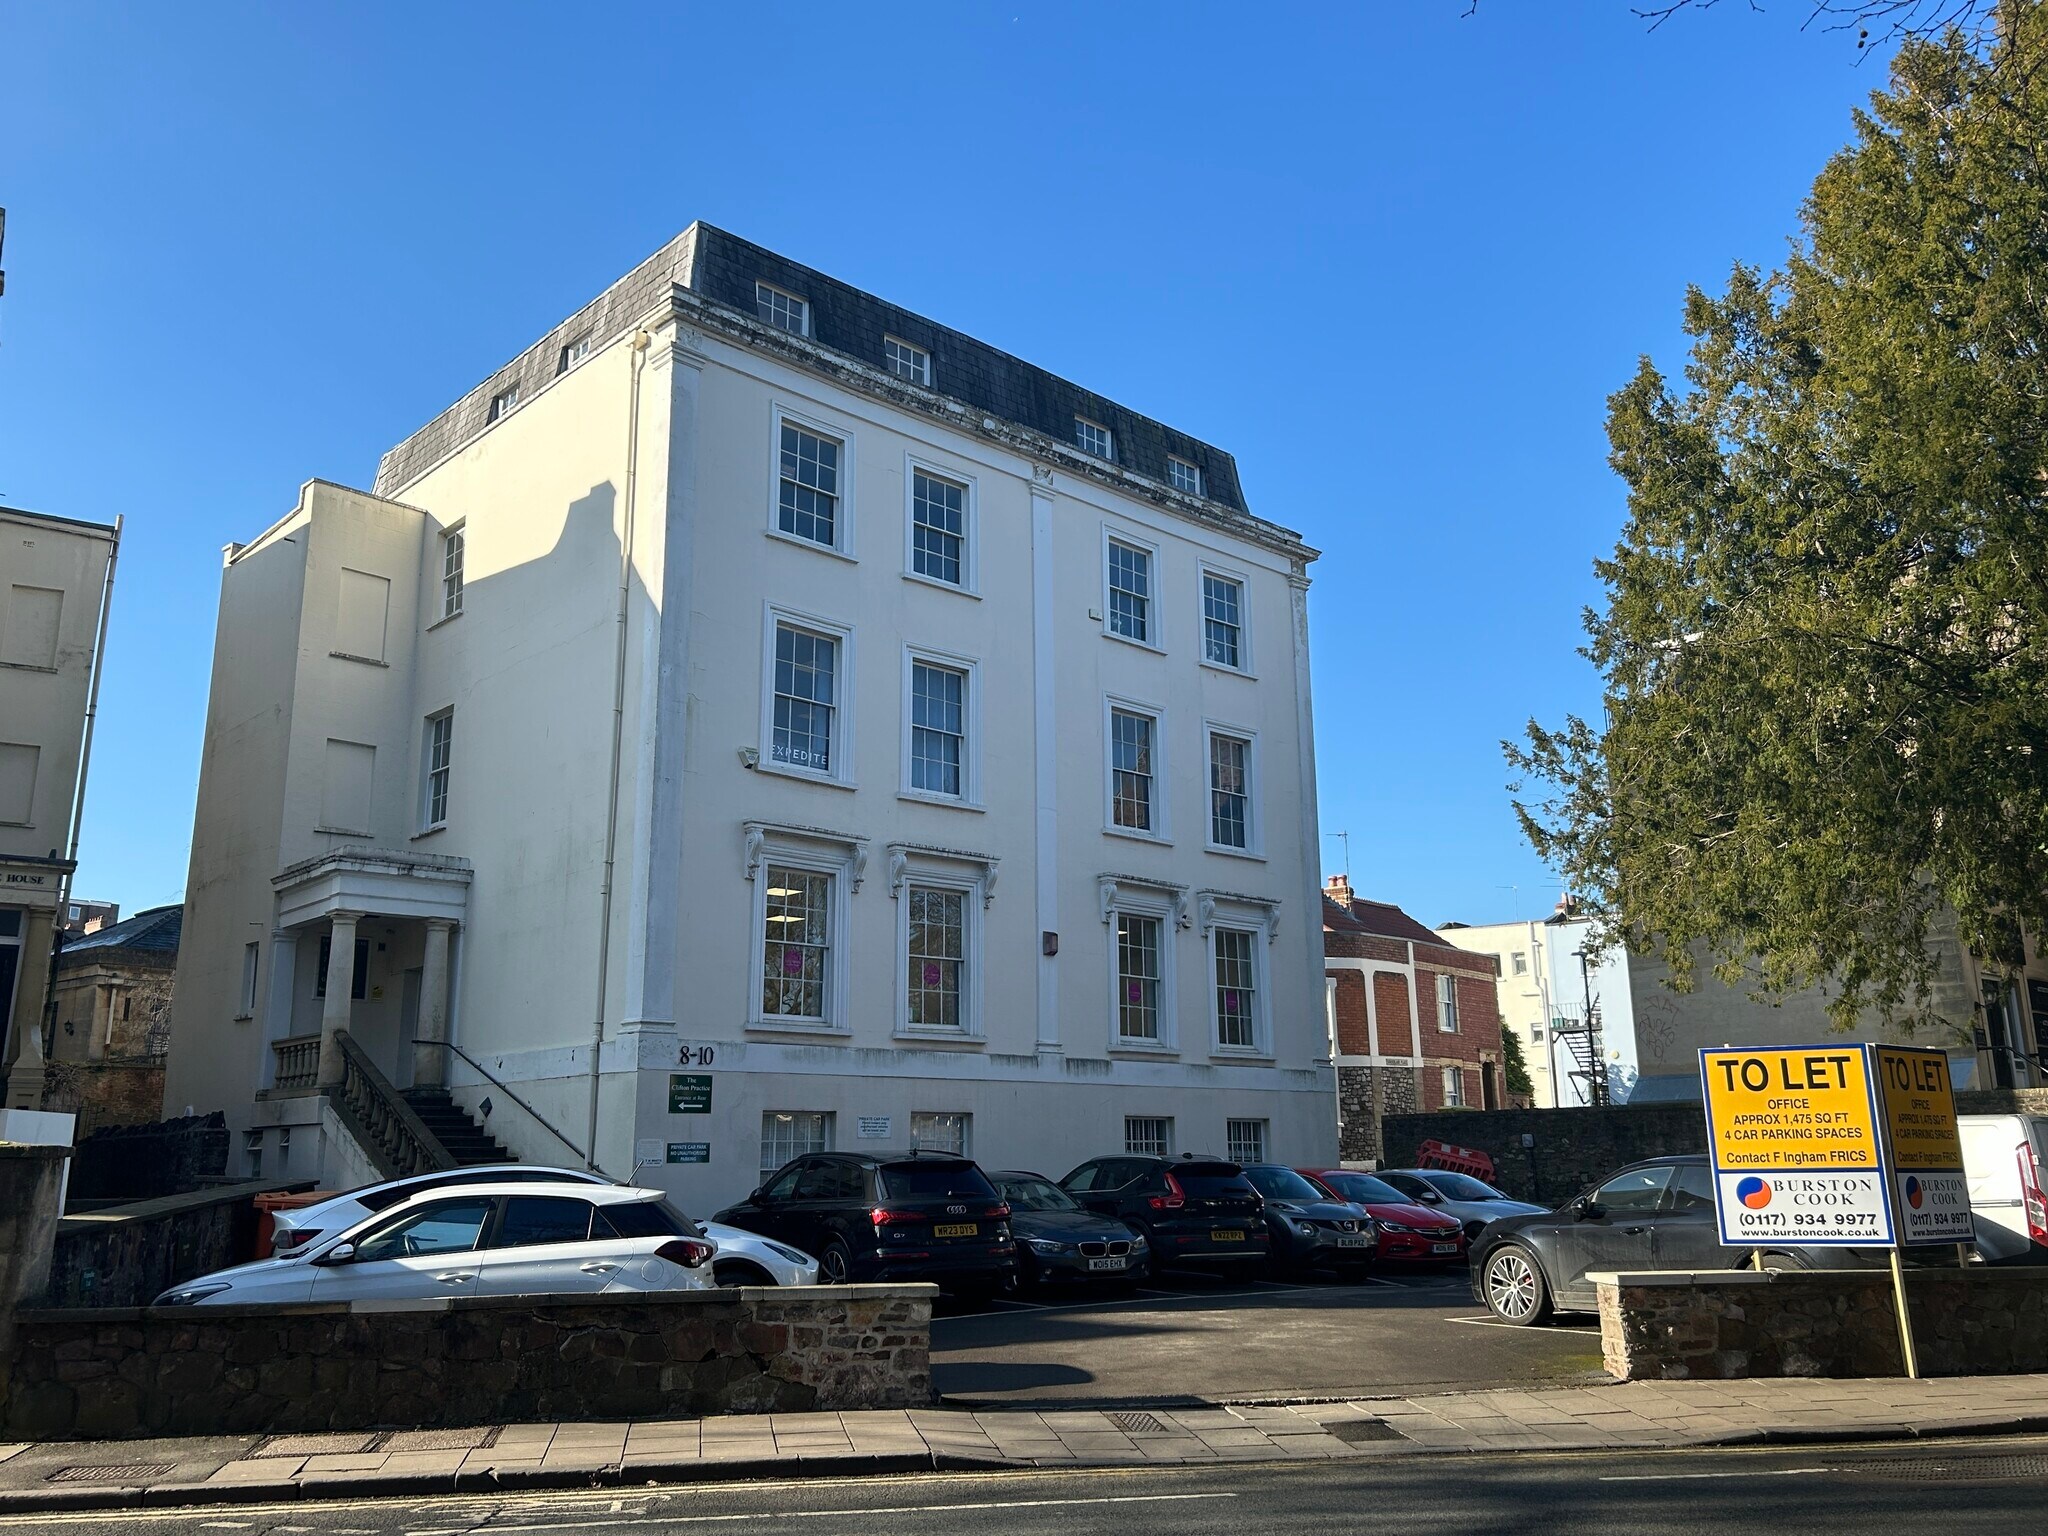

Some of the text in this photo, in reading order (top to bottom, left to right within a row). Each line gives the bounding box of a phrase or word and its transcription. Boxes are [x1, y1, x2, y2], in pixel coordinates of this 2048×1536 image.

[772, 744, 827, 765] EXPEDITE
[6, 874, 44, 884] HOUSE
[680, 1045, 714, 1066] 8-10
[1716, 1056, 1851, 1092] TO LET
[1884, 1056, 1943, 1092] TO LET
[1768, 1098, 1810, 1110] OFFICE
[1912, 1099, 1930, 1110] OFFICE
[1734, 1112, 1848, 1126] APPROX 1,475 SQ FT
[1724, 1128, 1863, 1140] 4 CAR PARKING SPACES
[1726, 1150, 1867, 1165] Contact F Ingham FRICS
[1898, 1152, 1918, 1162] Contact
[1773, 1179, 1872, 1192] BURSTON
[1922, 1179, 1964, 1192] BURSTON
[1794, 1193, 1855, 1206] COOK
[1932, 1192, 1958, 1205] COOK
[1739, 1212, 1878, 1226] (0117) 934 9977
[1910, 1212, 1968, 1226] (0117) 934 9977
[938, 1225, 975, 1237] WR23 DYS
[1740, 1228, 1880, 1237] www.burstoncook.co.uk
[1912, 1226, 1971, 1237] www.burstoncook.co.uk
[1110, 1259, 1122, 1269] EHX
